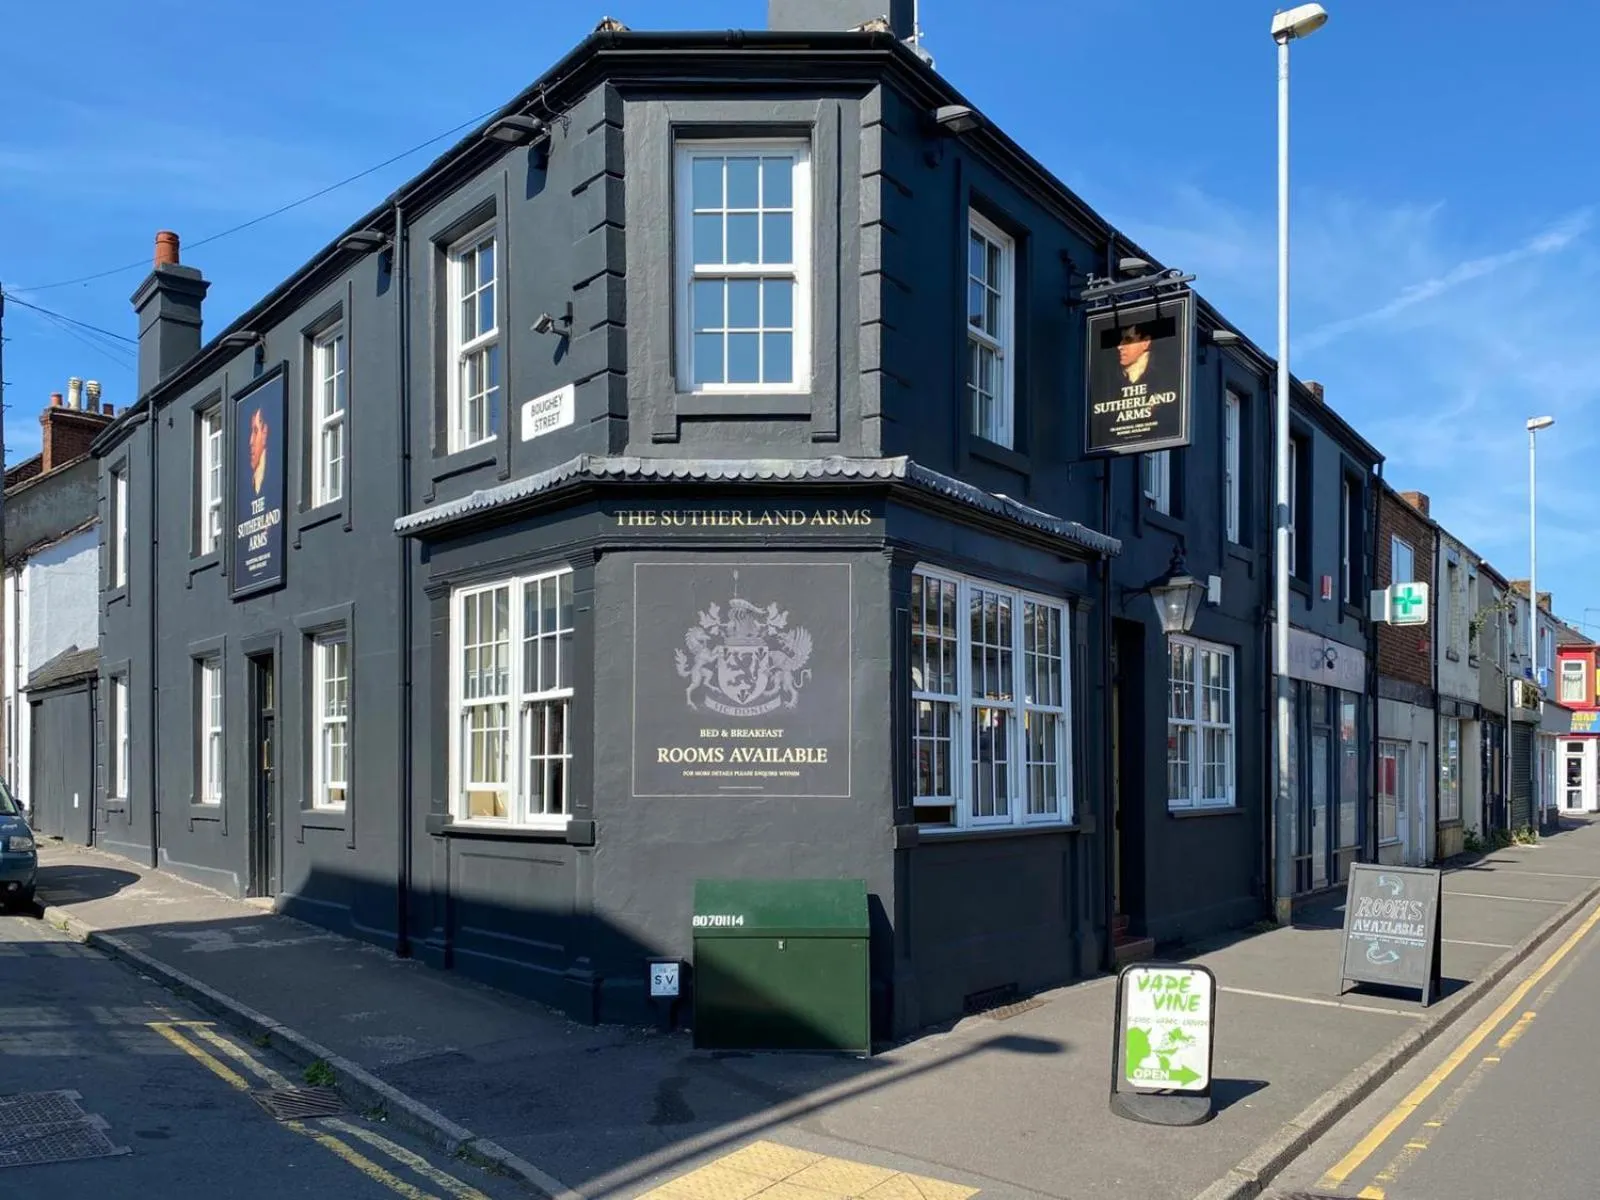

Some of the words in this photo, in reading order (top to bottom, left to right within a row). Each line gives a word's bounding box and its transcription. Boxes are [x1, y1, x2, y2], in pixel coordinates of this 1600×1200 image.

[1121, 383, 1148, 398] THE
[530, 392, 563, 418] BOUGHEY
[1093, 391, 1177, 414] SUTHERLAND
[534, 410, 561, 433] STREET
[1115, 407, 1153, 422] ARMS
[251, 496, 266, 515] THE
[237, 508, 281, 539] SUTHERLAND
[614, 510, 657, 526] THE
[660, 510, 807, 526] SUTHERLAND
[810, 509, 872, 526] ARMS
[248, 532, 269, 552] ARMS
[700, 729, 719, 738] BED
[721, 729, 728, 738] &
[730, 729, 784, 738] BREAKFAST
[657, 747, 724, 763] ROOMS
[729, 747, 828, 763] AVAILABLE
[1354, 896, 1424, 921] ROOMS
[1352, 918, 1425, 937] AVAILABLE
[1137, 974, 1193, 994] VAPE
[1152, 993, 1201, 1012] VINE
[1132, 1067, 1170, 1081] OPEN
